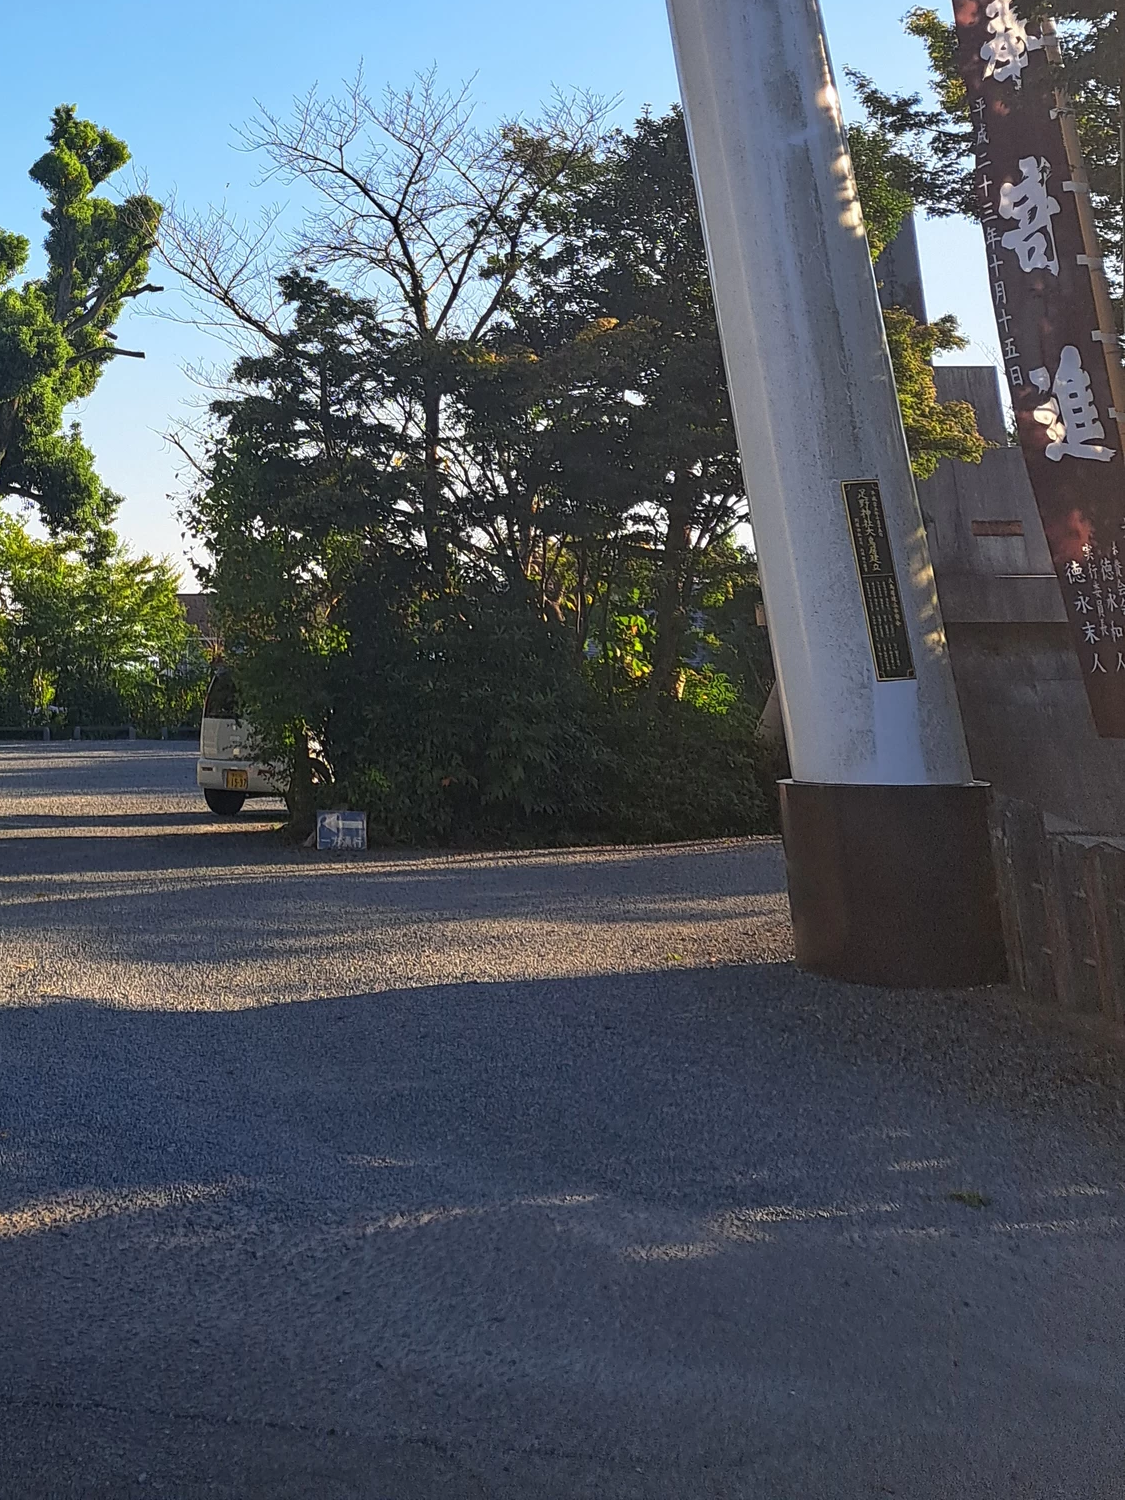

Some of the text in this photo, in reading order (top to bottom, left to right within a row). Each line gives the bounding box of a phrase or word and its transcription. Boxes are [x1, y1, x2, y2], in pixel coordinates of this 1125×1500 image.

[971, 97, 1024, 387] 平成二十三年十月十五日
[1081, 542, 1110, 637] 実行委員長
